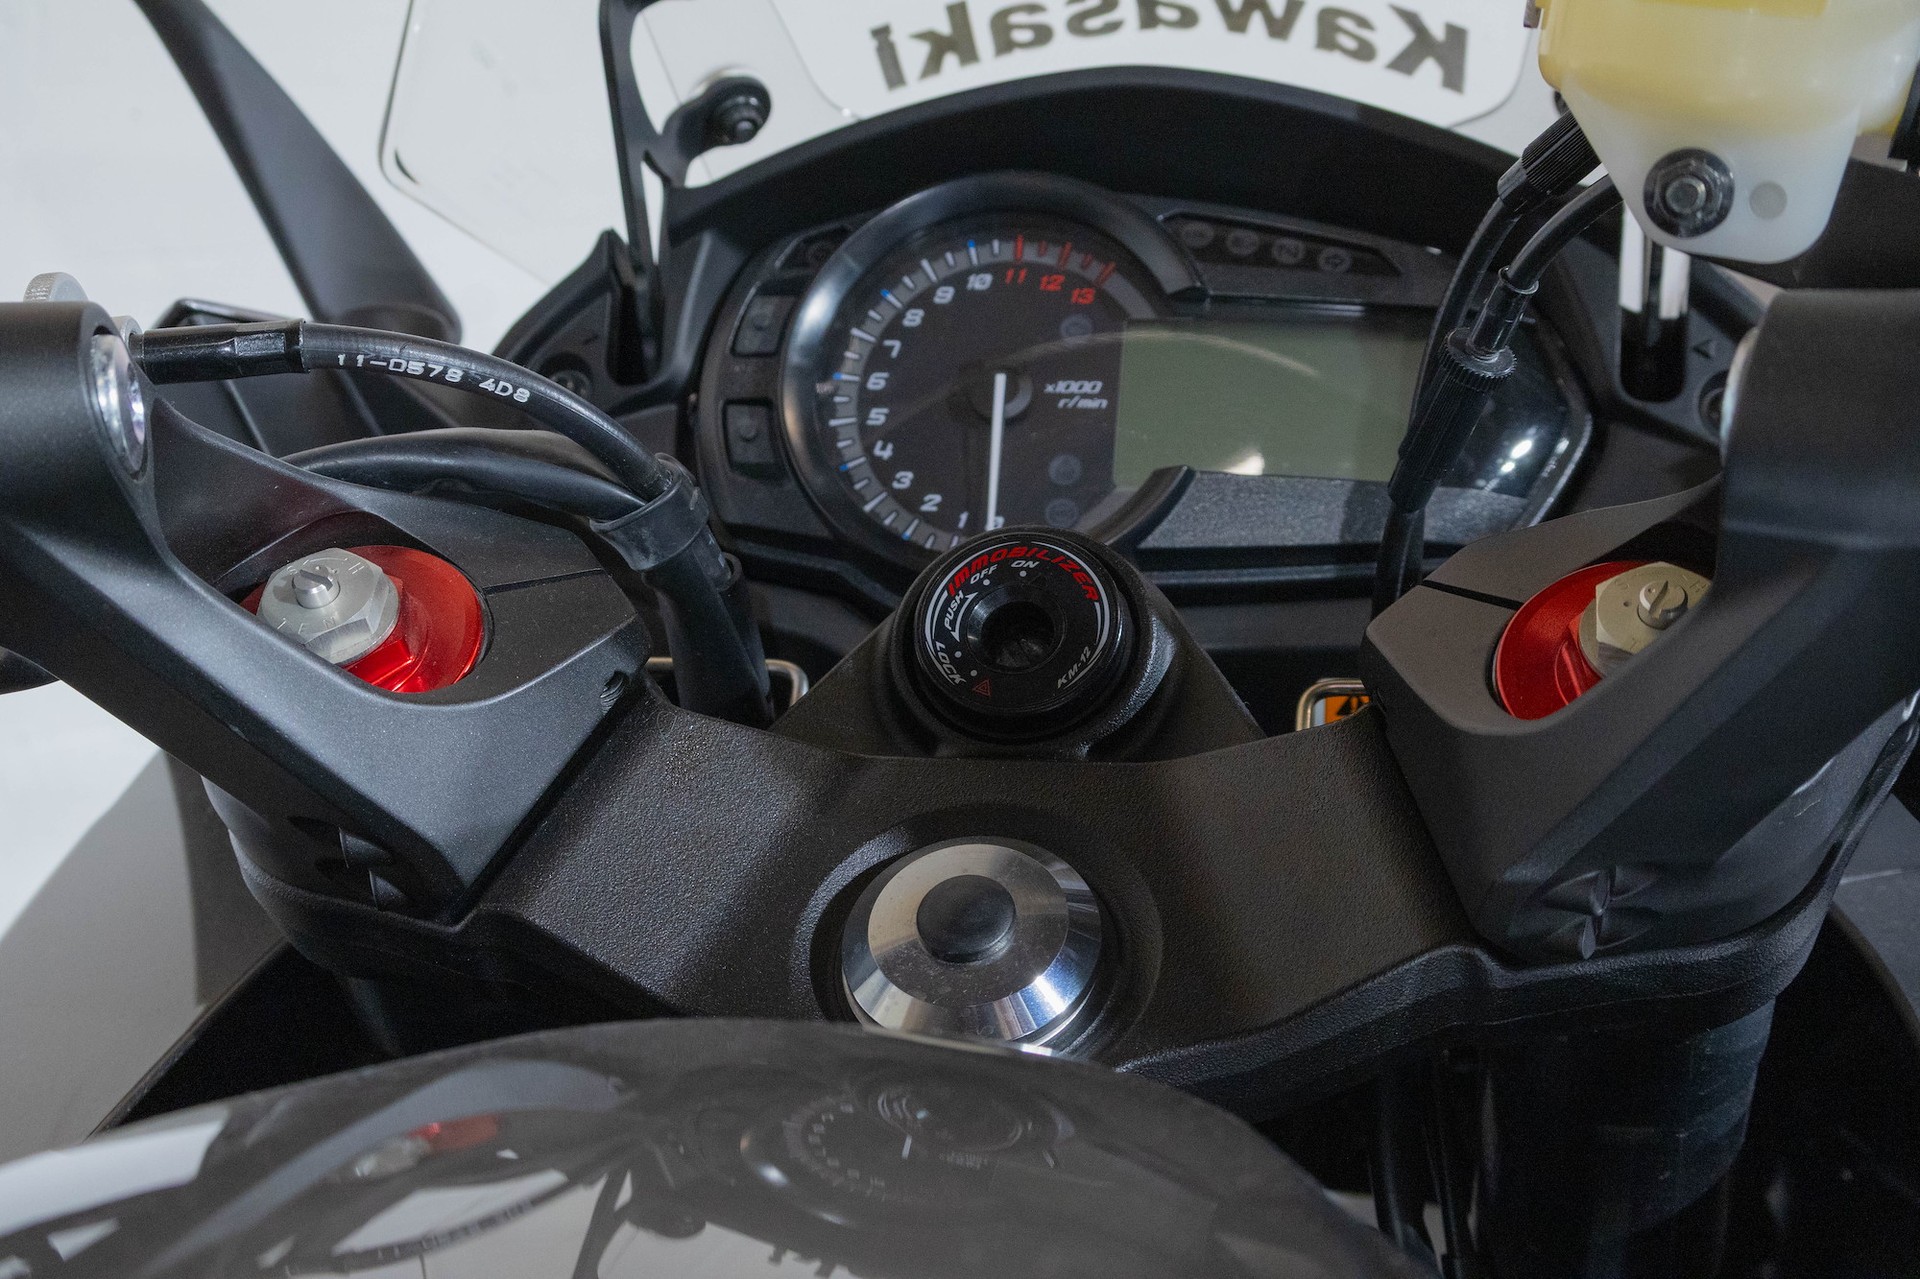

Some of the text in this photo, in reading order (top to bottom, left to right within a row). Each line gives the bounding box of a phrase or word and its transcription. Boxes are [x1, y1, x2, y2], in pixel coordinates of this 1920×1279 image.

[966, 273, 993, 291] 10
[1005, 269, 1027, 284] 11
[1040, 274, 1065, 291] 12
[933, 286, 955, 304] 9
[1071, 288, 1095, 304] 13
[902, 309, 925, 327] 8
[883, 340, 902, 358] 7
[867, 372, 889, 390] 6
[1057, 396, 1108, 409] r/min
[865, 408, 889, 426] 5
[873, 440, 894, 460] 4
[891, 471, 914, 490] 3
[920, 494, 943, 512] 2
[958, 511, 969, 529] 1
[947, 546, 1100, 601] IMMOBILIZER
[1010, 560, 1041, 569] ON
[970, 564, 998, 584] OFF
[944, 590, 964, 630] PUSH
[935, 641, 967, 685] LOCK
[1057, 646, 1091, 689] KM-12
